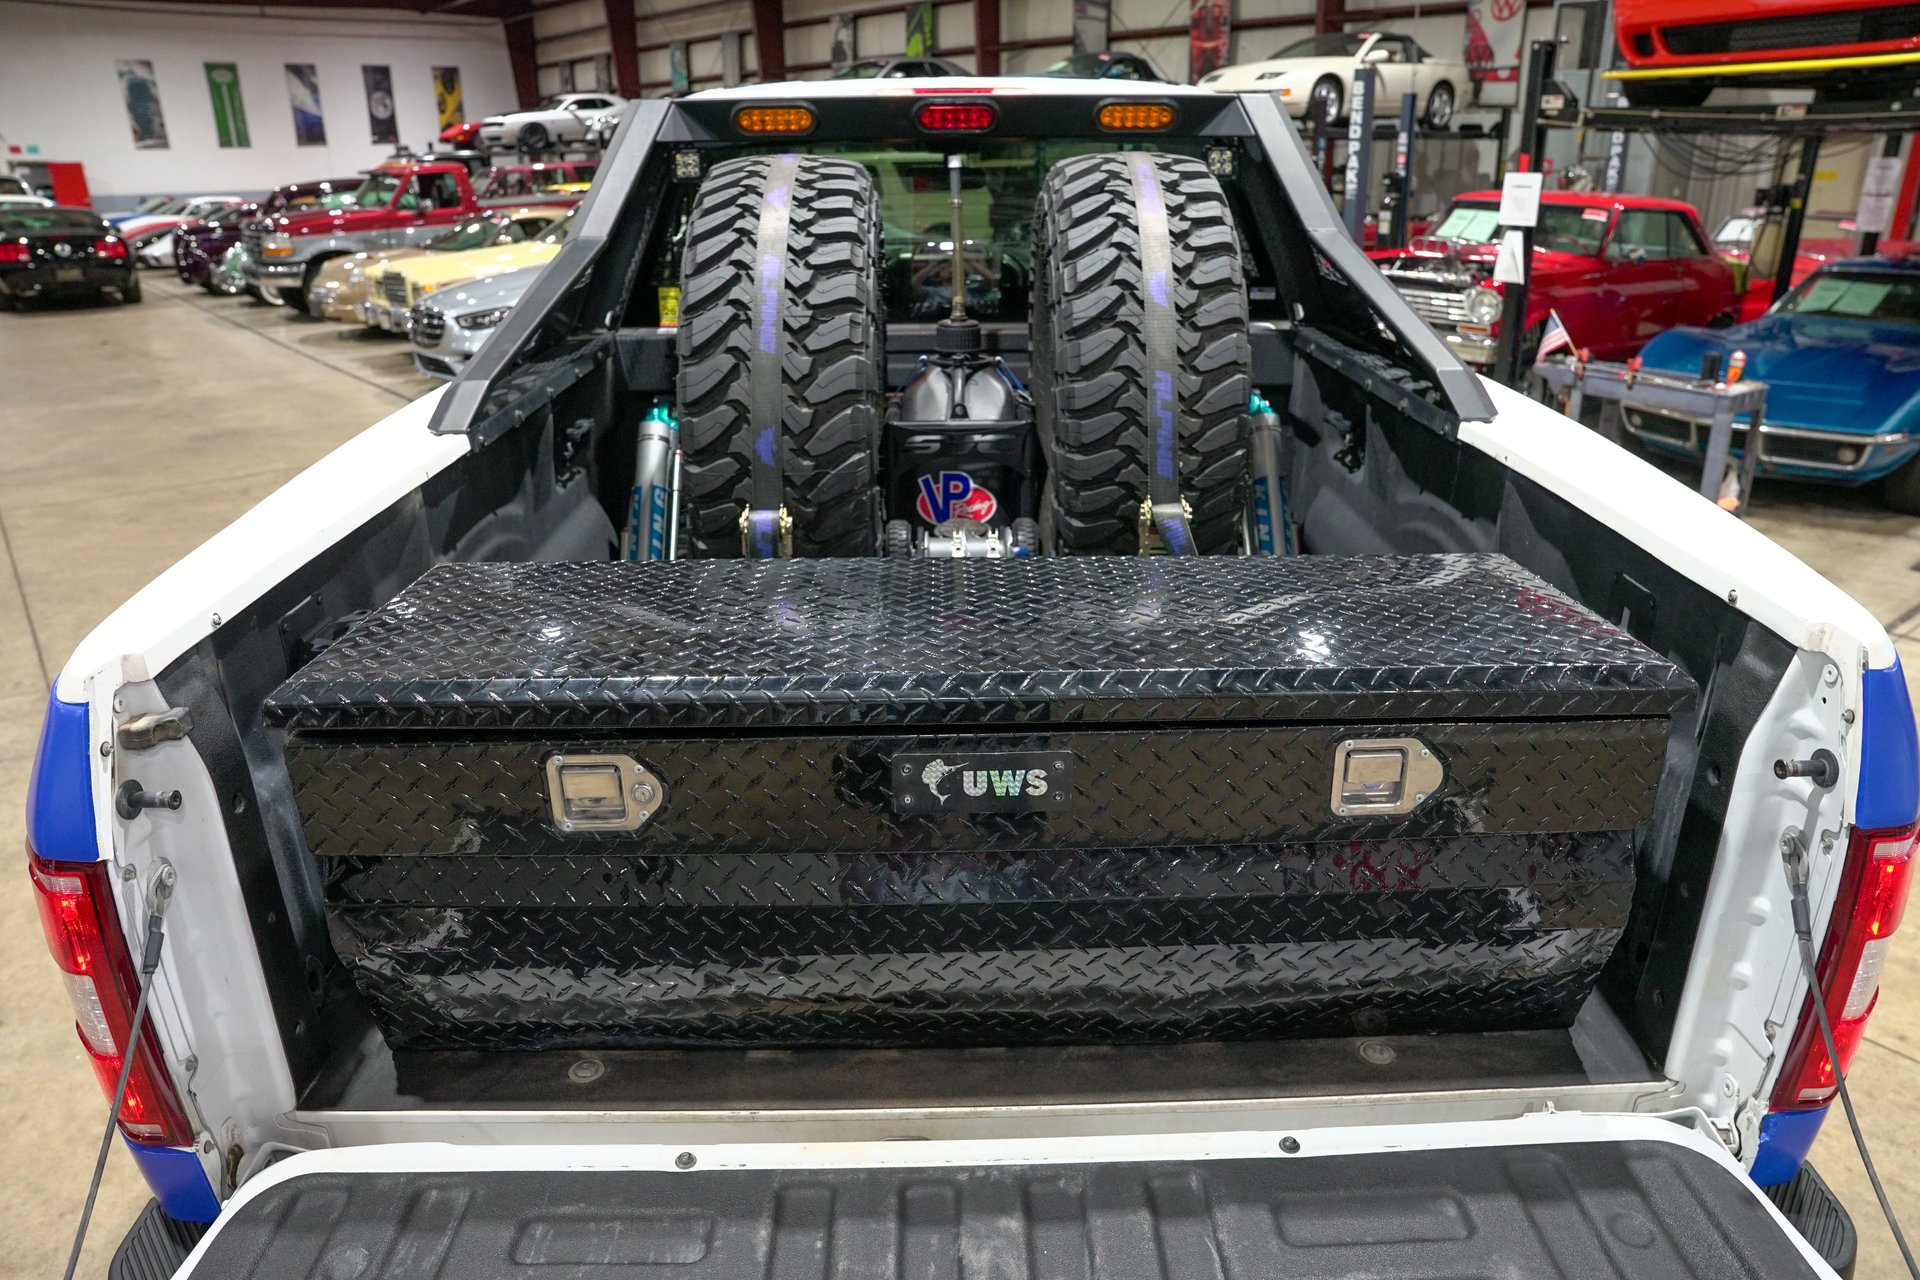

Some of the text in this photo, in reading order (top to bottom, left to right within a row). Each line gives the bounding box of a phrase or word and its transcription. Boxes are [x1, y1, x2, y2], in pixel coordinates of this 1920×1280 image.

[1151, 369, 1173, 480] ALPINE
[918, 470, 974, 525] VP
[962, 769, 1048, 797] UWS
